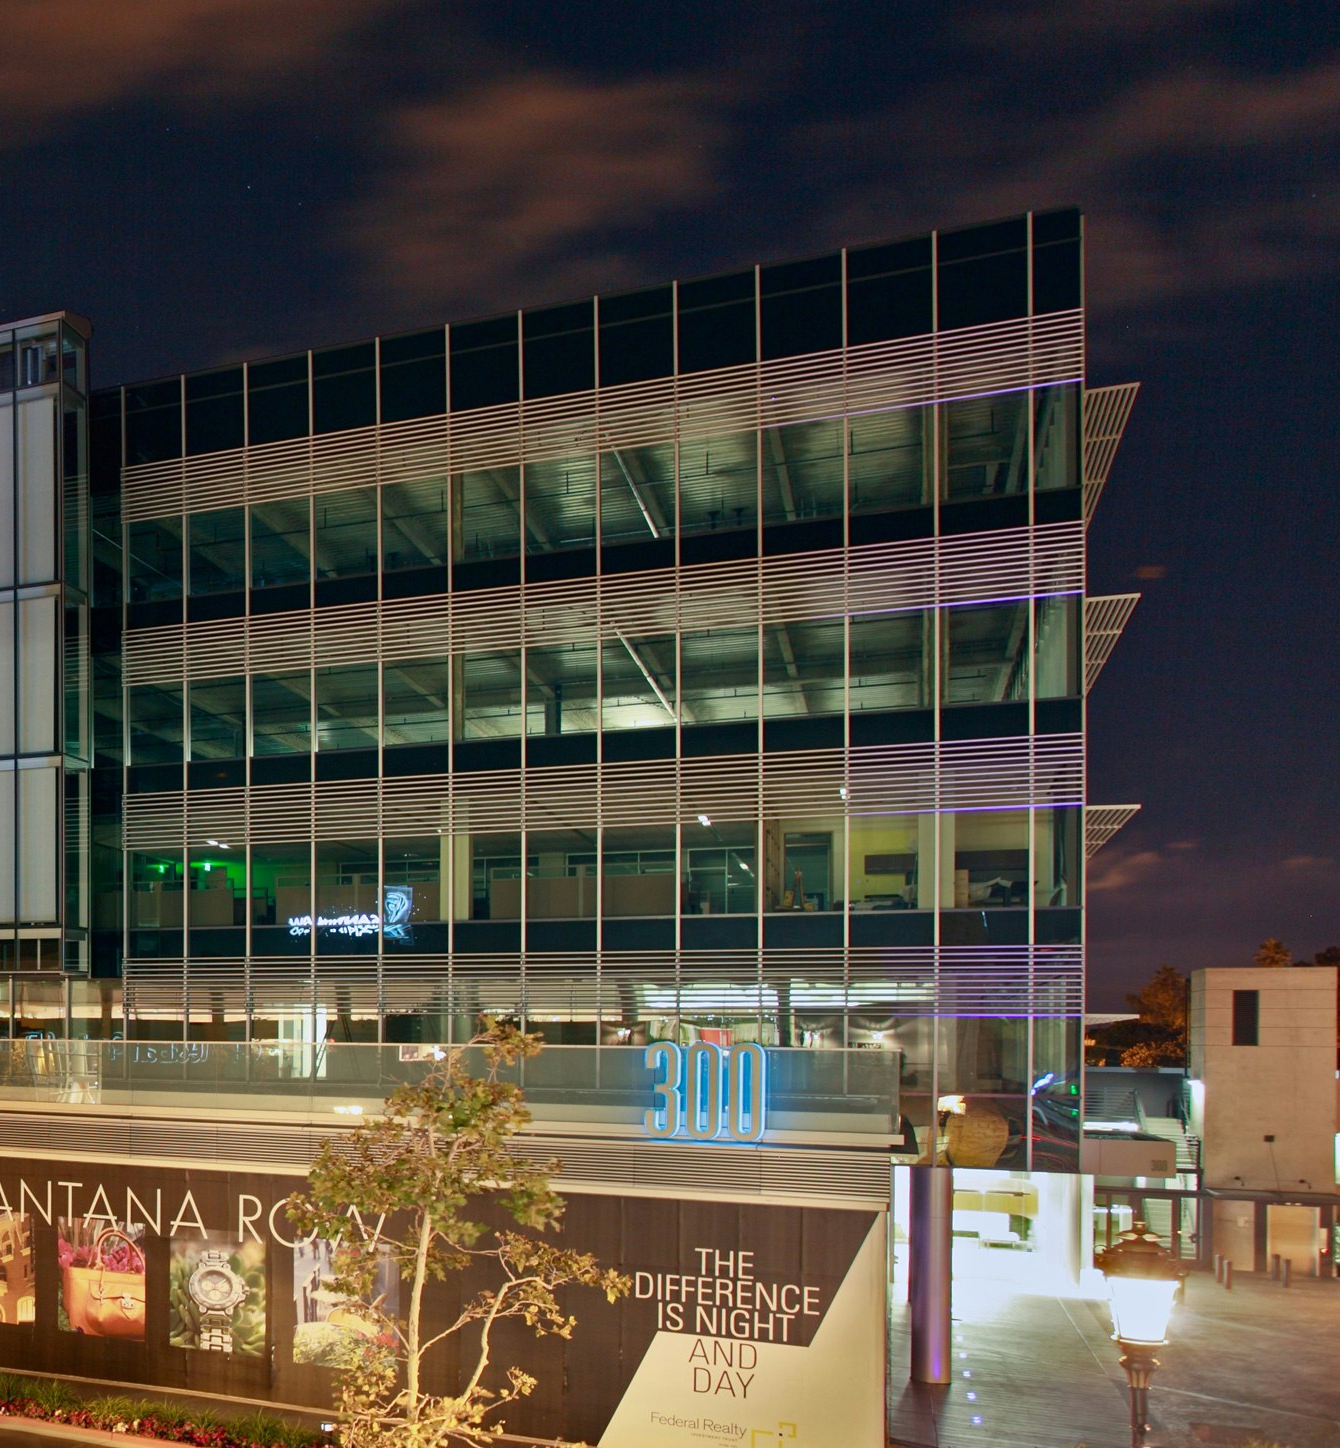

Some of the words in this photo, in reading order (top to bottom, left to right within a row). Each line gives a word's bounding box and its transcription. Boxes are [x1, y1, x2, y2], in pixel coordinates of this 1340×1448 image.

[645, 1041, 766, 1142] 300
[694, 1247, 754, 1280] THE
[635, 1271, 820, 1316] DIFFERENCE
[657, 1302, 684, 1331] IS
[696, 1305, 796, 1342] NIGHT
[688, 1338, 758, 1370] AND
[693, 1367, 755, 1399] DAY
[650, 1411, 700, 1430] Federal
[703, 1418, 748, 1440] Realty
